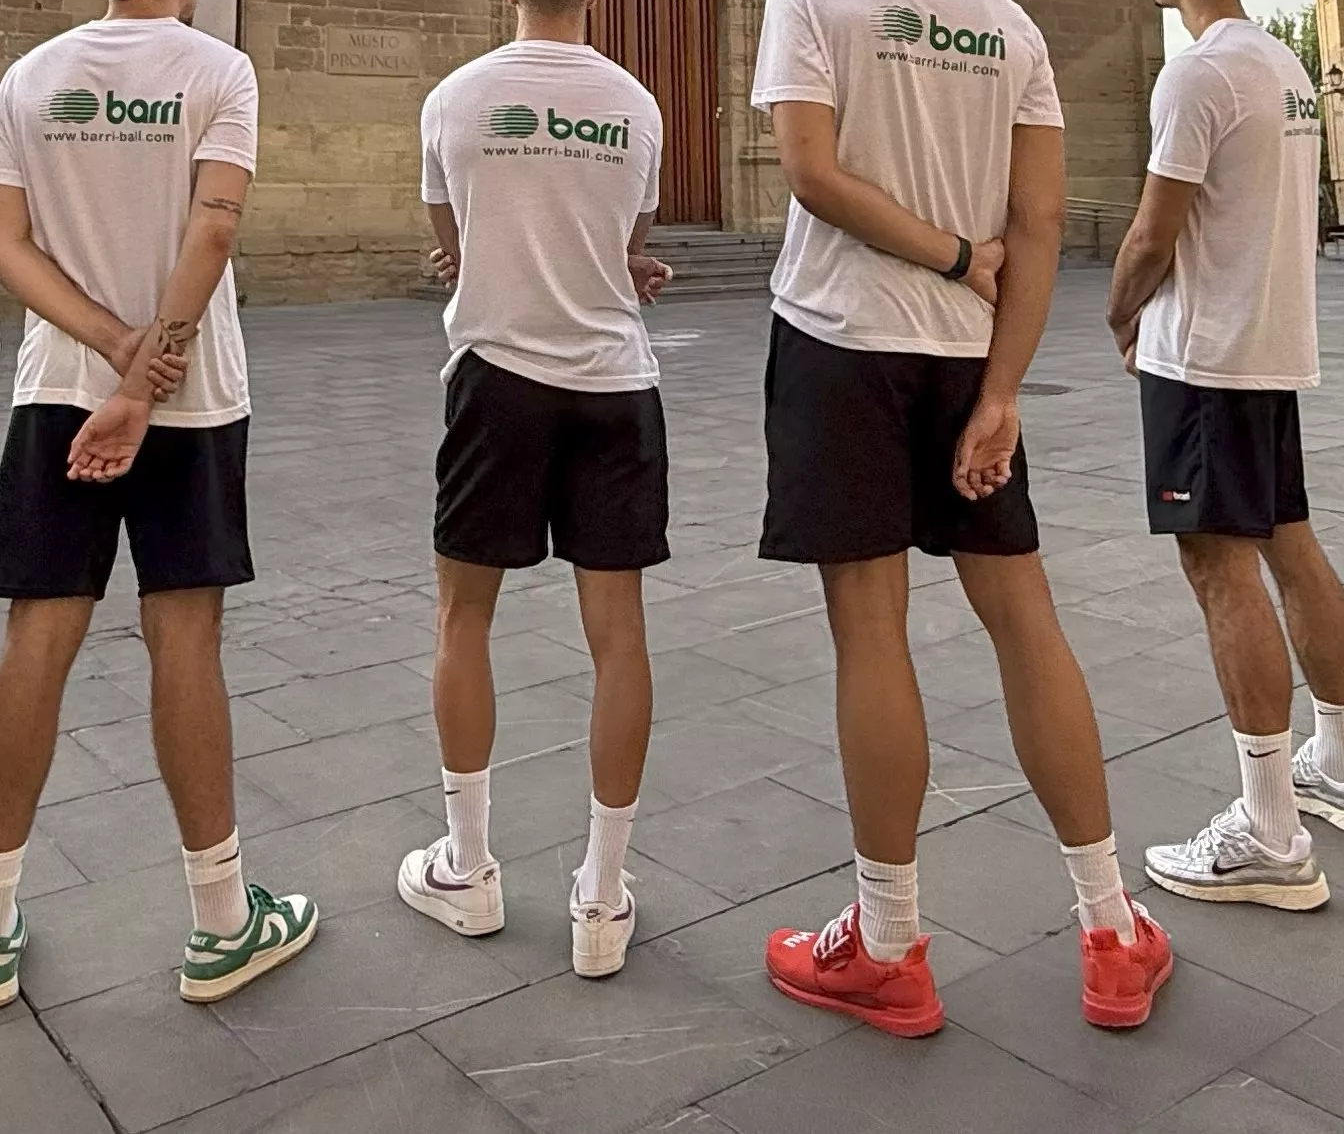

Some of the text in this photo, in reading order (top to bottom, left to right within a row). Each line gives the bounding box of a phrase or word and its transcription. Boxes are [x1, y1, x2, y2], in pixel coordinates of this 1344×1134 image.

[929, 13, 1006, 61] barri
[330, 53, 414, 71] PROVINCIA
[106, 90, 185, 125] barri
[43, 130, 175, 143] www.barri-ball.com
[547, 108, 631, 150] barri
[483, 144, 624, 165] www.barri-ball.com
